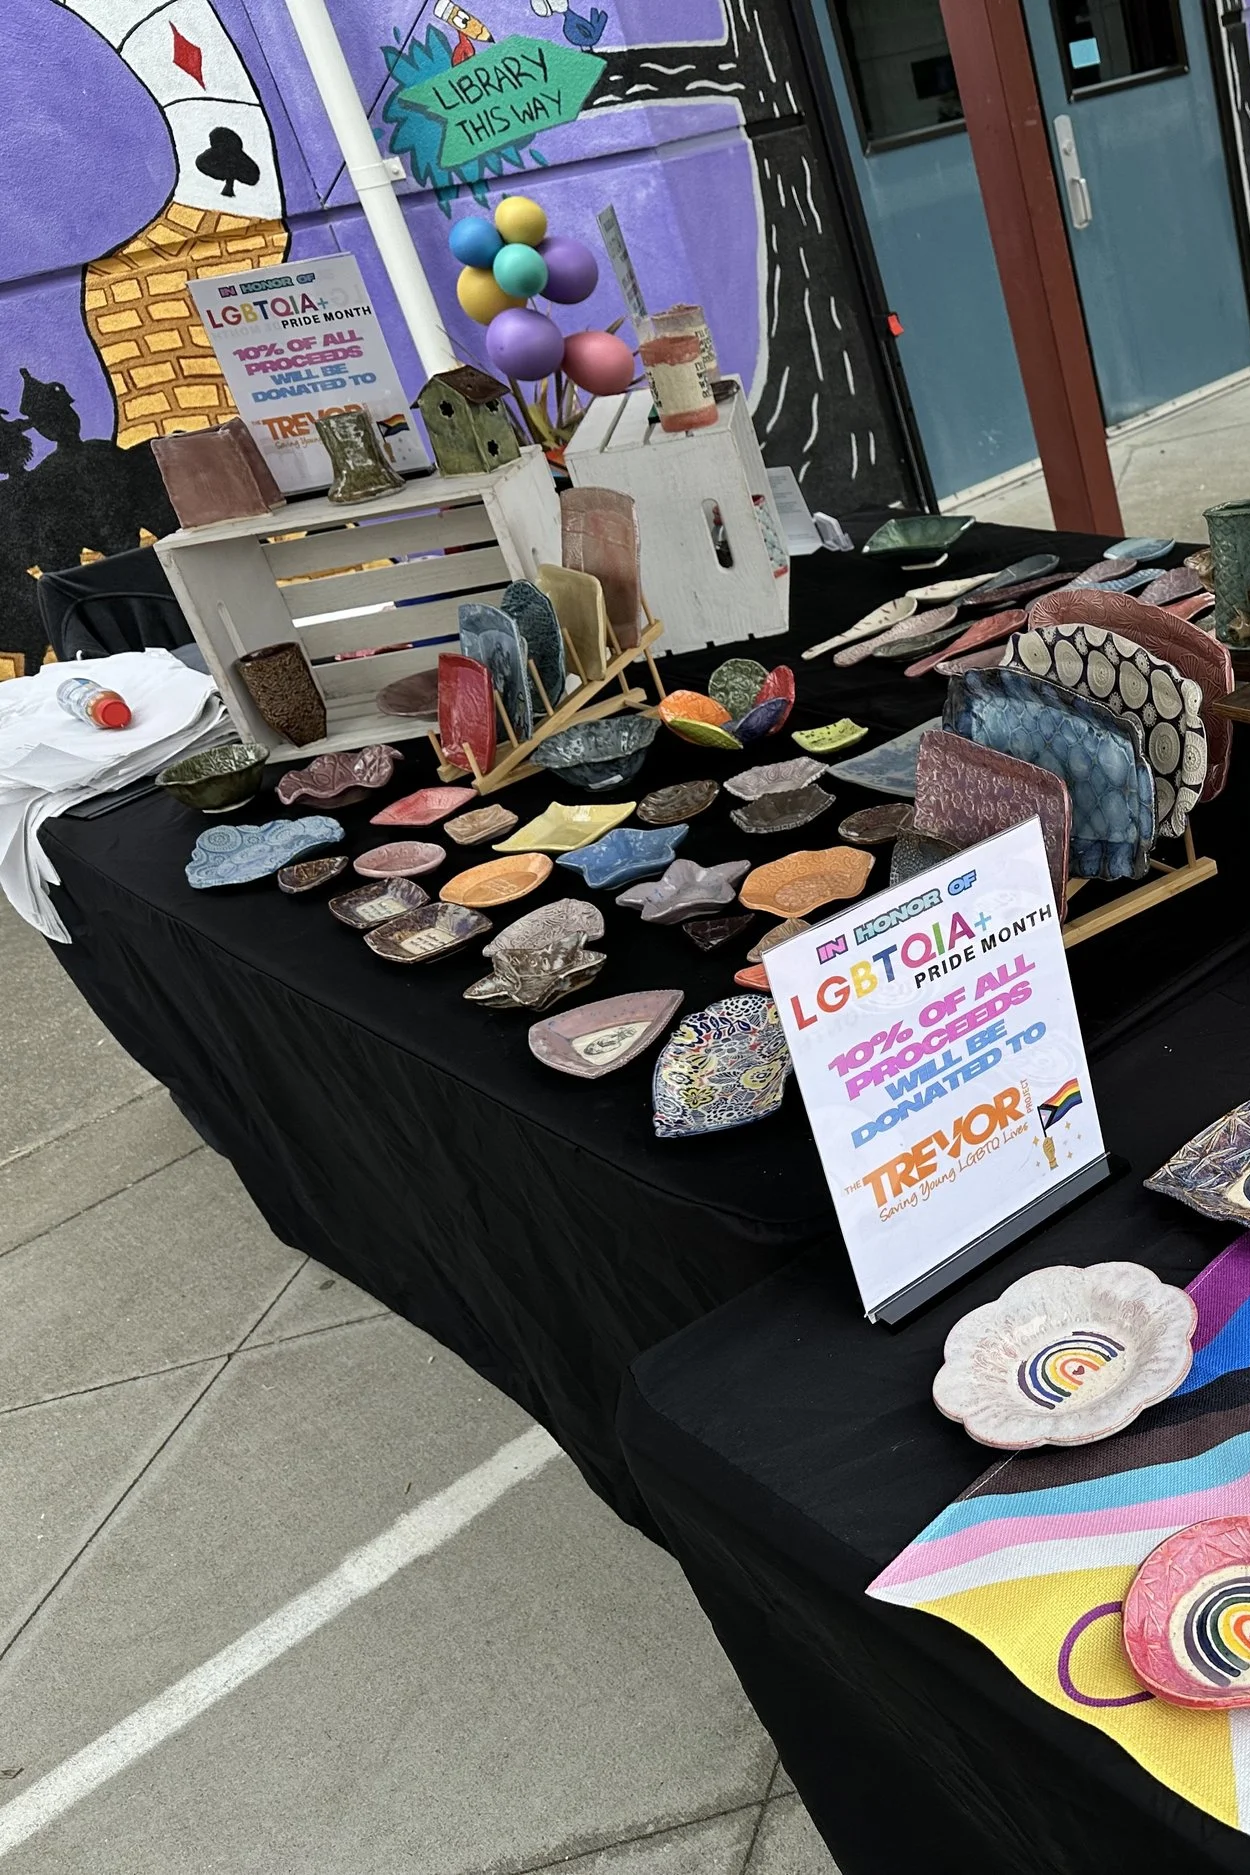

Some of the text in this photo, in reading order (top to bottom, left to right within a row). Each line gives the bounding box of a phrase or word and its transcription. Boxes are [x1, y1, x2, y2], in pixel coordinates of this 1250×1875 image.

[432, 47, 548, 110] LIBRARY
[456, 89, 562, 145] THIS WAY
[206, 293, 329, 329] LGBTQIA+
[219, 273, 315, 298] IN HONOR OF
[233, 330, 364, 361] 10% OF ALL
[281, 306, 372, 329] PRIDE MONTH
[245, 345, 363, 376] PROCEEDS
[252, 372, 377, 403] DONATED TO
[270, 363, 348, 385] WILL BE
[816, 869, 977, 965] IN HONOR OF
[914, 904, 1052, 989] PRIDE MONTH
[790, 911, 992, 1030] LGBTQIA+
[828, 954, 1036, 1077] 10% OF ALL
[845, 980, 1032, 1101] PROCEEDS
[851, 1021, 1046, 1149] DONATED TO
[885, 1019, 1008, 1101] WILL BE
[1020, 1078, 1034, 1114] PROJECT
[844, 1086, 1025, 1208] THE TREVOR
[879, 1121, 1029, 1222] Saving Young LGBTQ Lives
